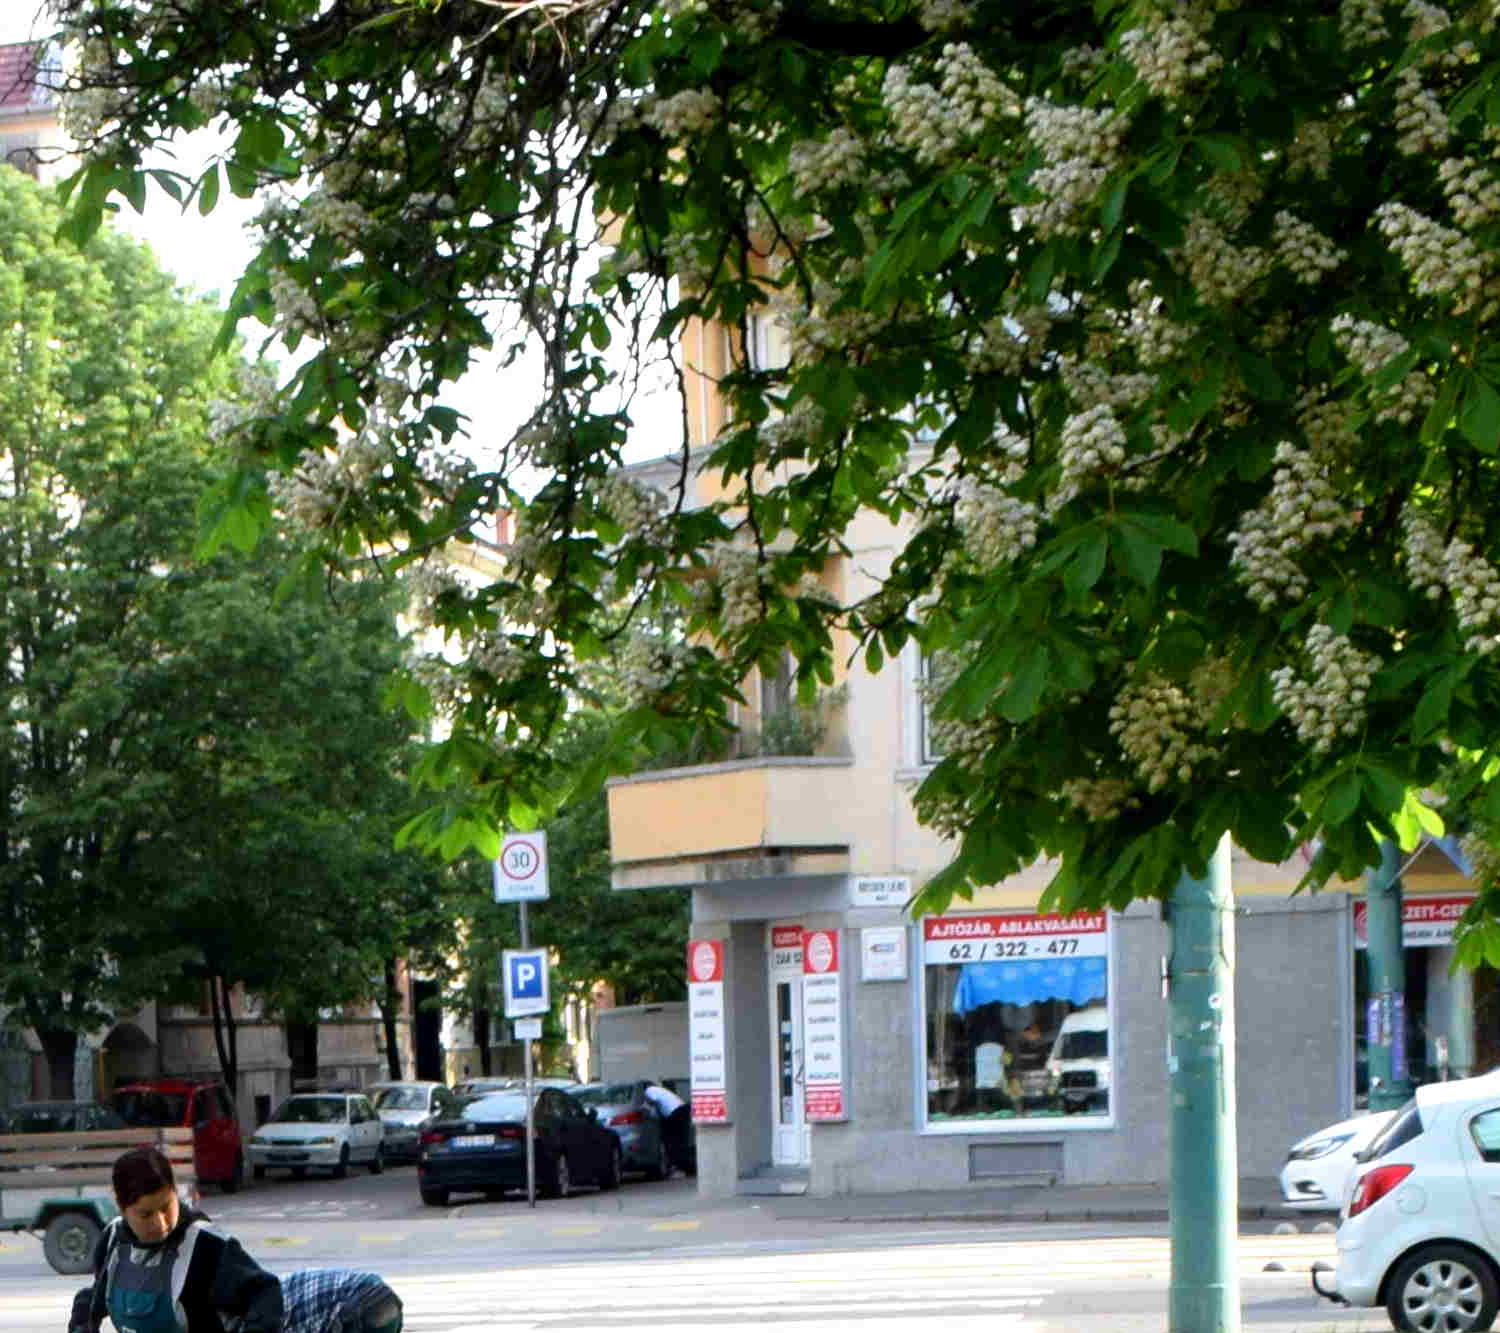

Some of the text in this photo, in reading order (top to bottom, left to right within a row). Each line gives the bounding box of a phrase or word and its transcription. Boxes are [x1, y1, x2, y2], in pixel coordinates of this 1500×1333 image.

[511, 851, 529, 868] 30
[1404, 904, 1467, 920] ZETT-CER
[950, 943, 971, 959] 62
[995, 941, 1028, 957] 322
[1048, 939, 1079, 954] 477
[517, 964, 535, 990] P
